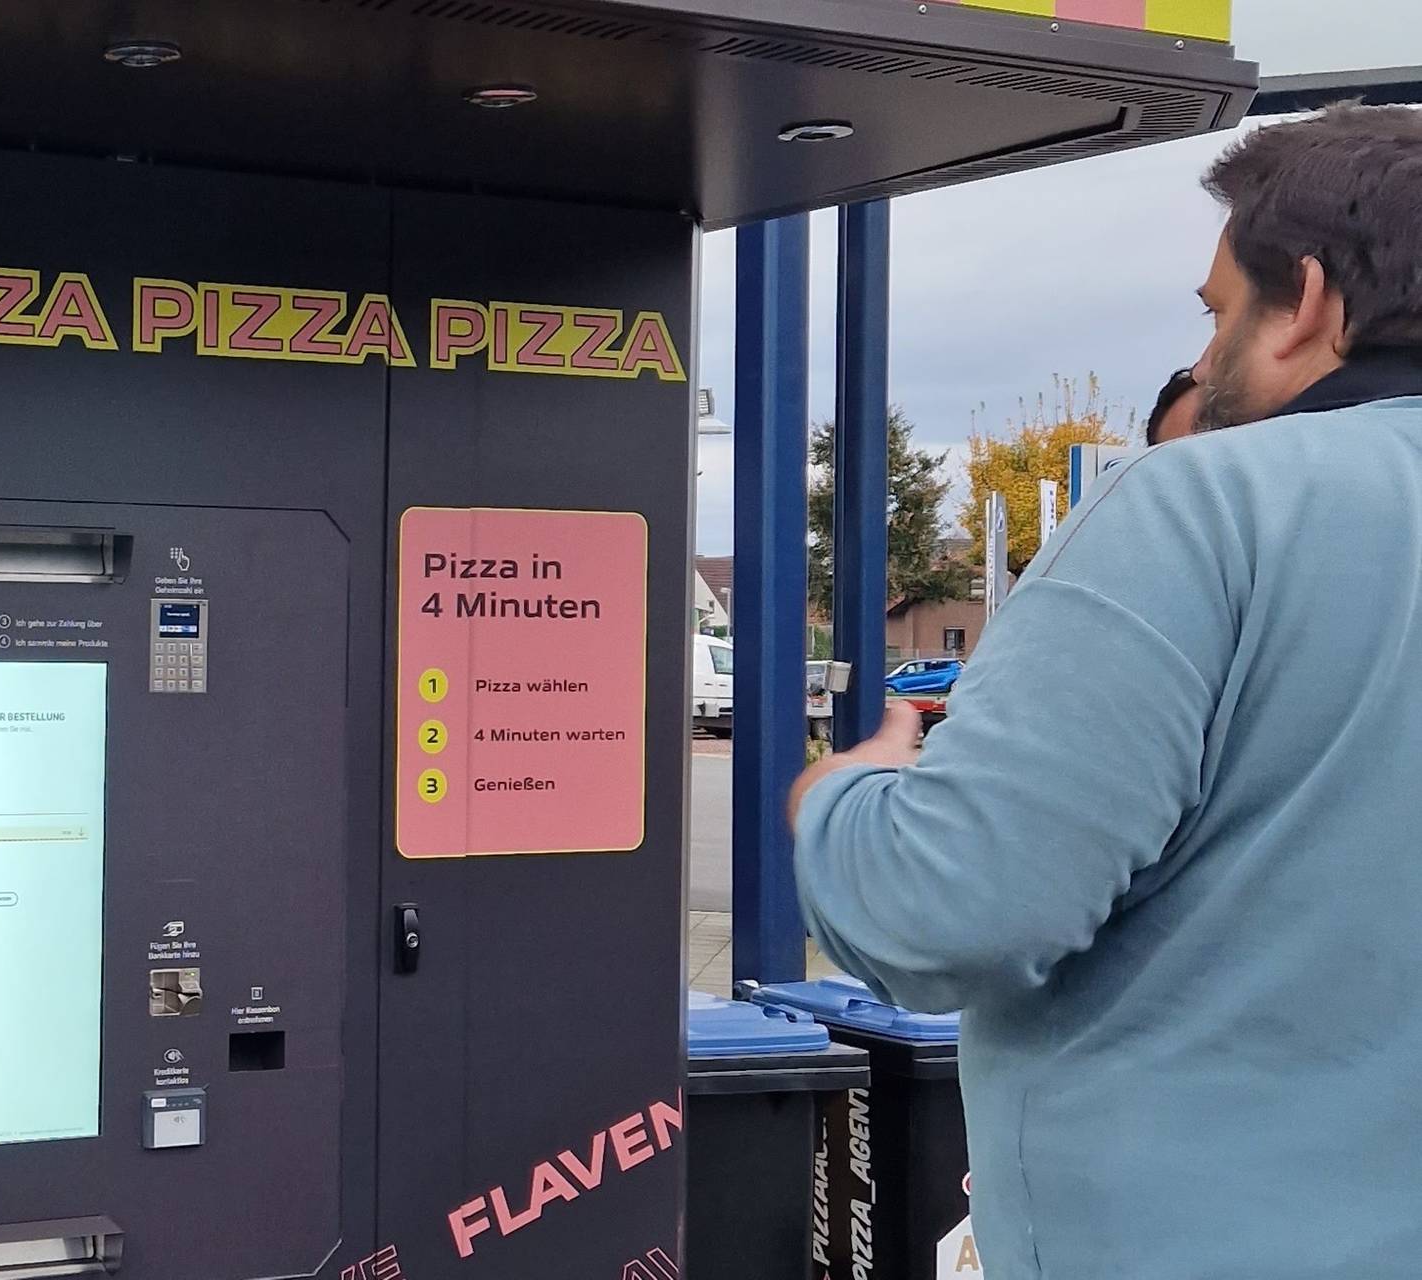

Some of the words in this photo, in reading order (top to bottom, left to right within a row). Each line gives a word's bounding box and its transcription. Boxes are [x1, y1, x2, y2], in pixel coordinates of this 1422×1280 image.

[140, 285, 413, 364] PIZZA
[436, 305, 680, 376] PIZZA
[423, 552, 519, 579] Pizza
[531, 553, 562, 580] in
[421, 592, 444, 618] 4
[456, 591, 601, 619] Minuten
[58, 620, 86, 629] Zahlung
[55, 640, 77, 648] meine
[78, 640, 109, 648] Produkte
[475, 679, 522, 693] Pizza
[526, 678, 589, 693] wählen
[7, 712, 66, 721] BESTELLUNG
[474, 729, 485, 741] 4
[490, 728, 561, 742] Minuten
[566, 730, 626, 742] warten
[474, 777, 556, 792] Genießen
